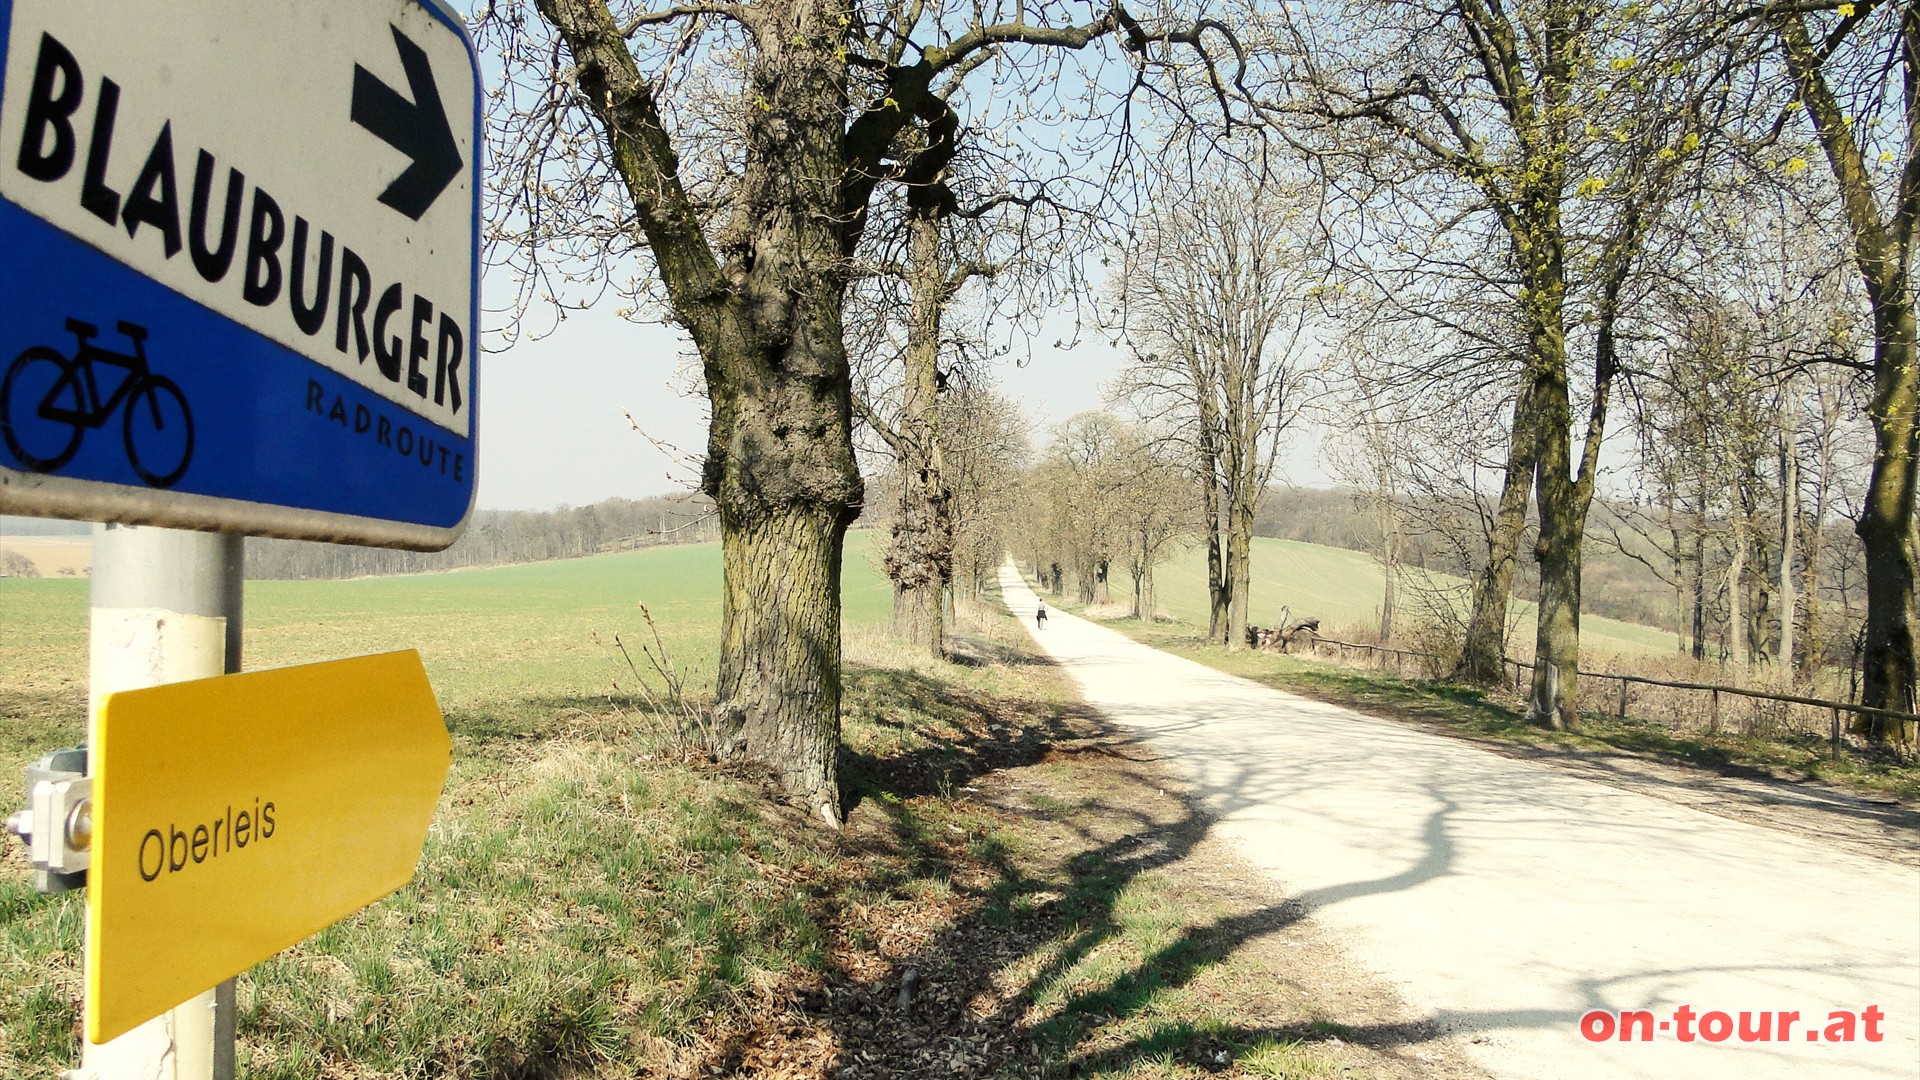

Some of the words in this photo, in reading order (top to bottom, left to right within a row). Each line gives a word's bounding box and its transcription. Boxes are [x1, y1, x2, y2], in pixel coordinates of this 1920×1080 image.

[17, 31, 463, 415] BLAUBURGER
[306, 379, 463, 483] RADROUTE
[138, 797, 276, 882] Oberleis
